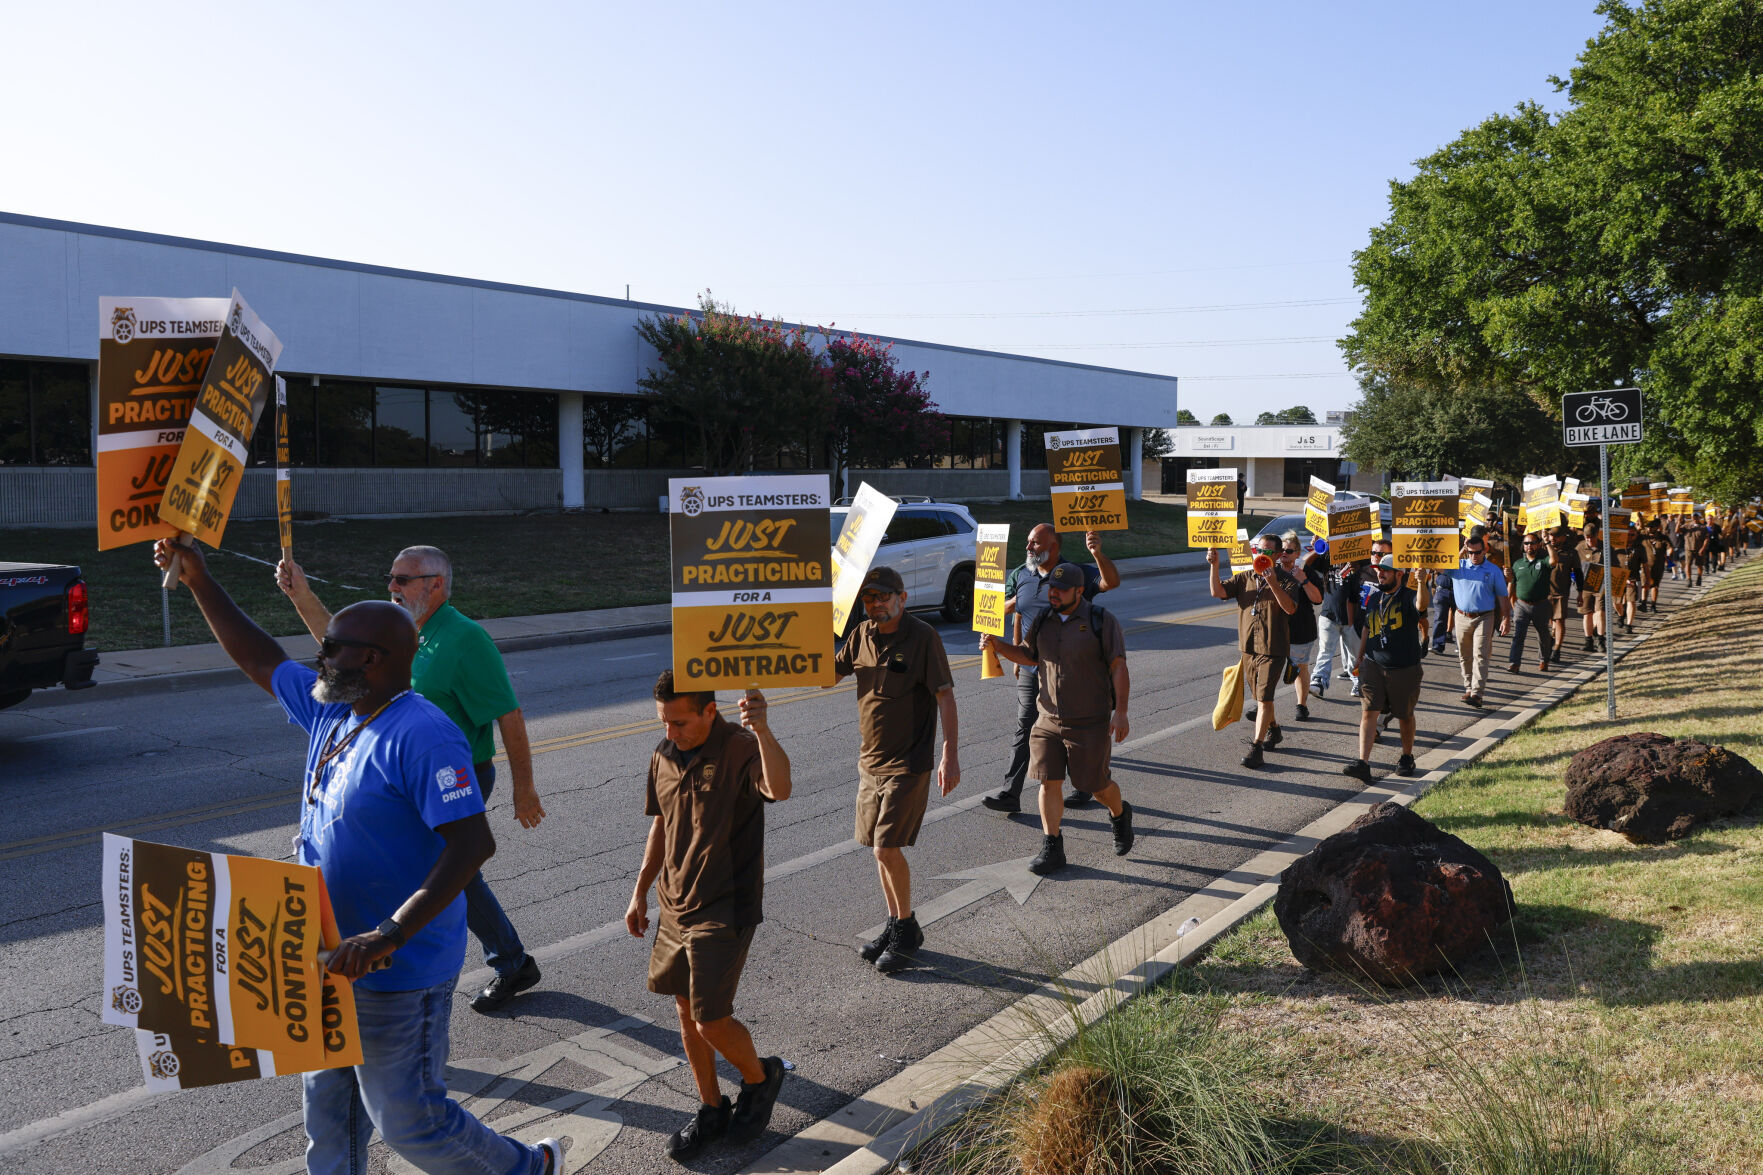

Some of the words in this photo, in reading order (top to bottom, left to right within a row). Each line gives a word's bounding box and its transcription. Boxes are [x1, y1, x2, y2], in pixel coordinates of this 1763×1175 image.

[140, 320, 166, 334] UPS
[240, 321, 251, 342] UPS
[135, 348, 215, 384] JUST
[226, 354, 263, 399] JUST
[157, 431, 184, 443] FOR
[214, 430, 228, 446] FOR
[228, 439, 234, 450] A
[1297, 436, 1302, 444] J
[1309, 436, 1315, 444] S
[1568, 427, 1599, 442] BIKE
[1603, 425, 1638, 440] LANE
[1076, 437, 1115, 446] TEAMSTERS:
[1063, 449, 1105, 467] JUST
[191, 448, 235, 490] JUST
[1054, 470, 1118, 483] PRACTICING
[1197, 484, 1227, 497] JUST
[1313, 489, 1329, 501] JUST
[707, 495, 735, 508] UPS
[737, 493, 822, 507] TEAMSTERS:
[1068, 494, 1109, 510] JUST
[1190, 501, 1235, 509] PRACTICING
[1405, 499, 1445, 513] JUST
[1060, 514, 1121, 526] CONTRACT
[1311, 513, 1326, 526] JUST
[1337, 511, 1363, 523] JUST
[1395, 517, 1455, 526] PRACTICING
[1197, 520, 1227, 530] JUST
[1306, 521, 1328, 535] CONTRACT
[1330, 522, 1369, 535] PRACTICING
[706, 518, 797, 550] JUST
[1191, 535, 1234, 543] CONTRACT
[1338, 537, 1363, 549] JUST
[1406, 537, 1445, 549] JUST
[981, 546, 1000, 562] JUST
[1333, 549, 1370, 561] CONTRACT
[1397, 554, 1455, 564] CONTRACT
[682, 561, 822, 585] PRACTICING
[976, 568, 1004, 580] PRACTICING
[733, 592, 759, 603] FOR
[761, 591, 772, 602] A
[979, 593, 997, 609] JUST
[708, 611, 799, 643] JUST
[975, 614, 1002, 629] CONTRACT
[686, 653, 823, 678] CONTRACT
[442, 785, 473, 803] DRIVE
[118, 847, 133, 947] TEAMSTERS:
[141, 883, 173, 995] JUST
[215, 927, 226, 940] A
[183, 861, 211, 1029] PRACTICING
[215, 941, 227, 975] FOR
[235, 897, 268, 1012] JUST
[280, 876, 309, 1043] CONTRACT
[120, 951, 134, 982] UPS
